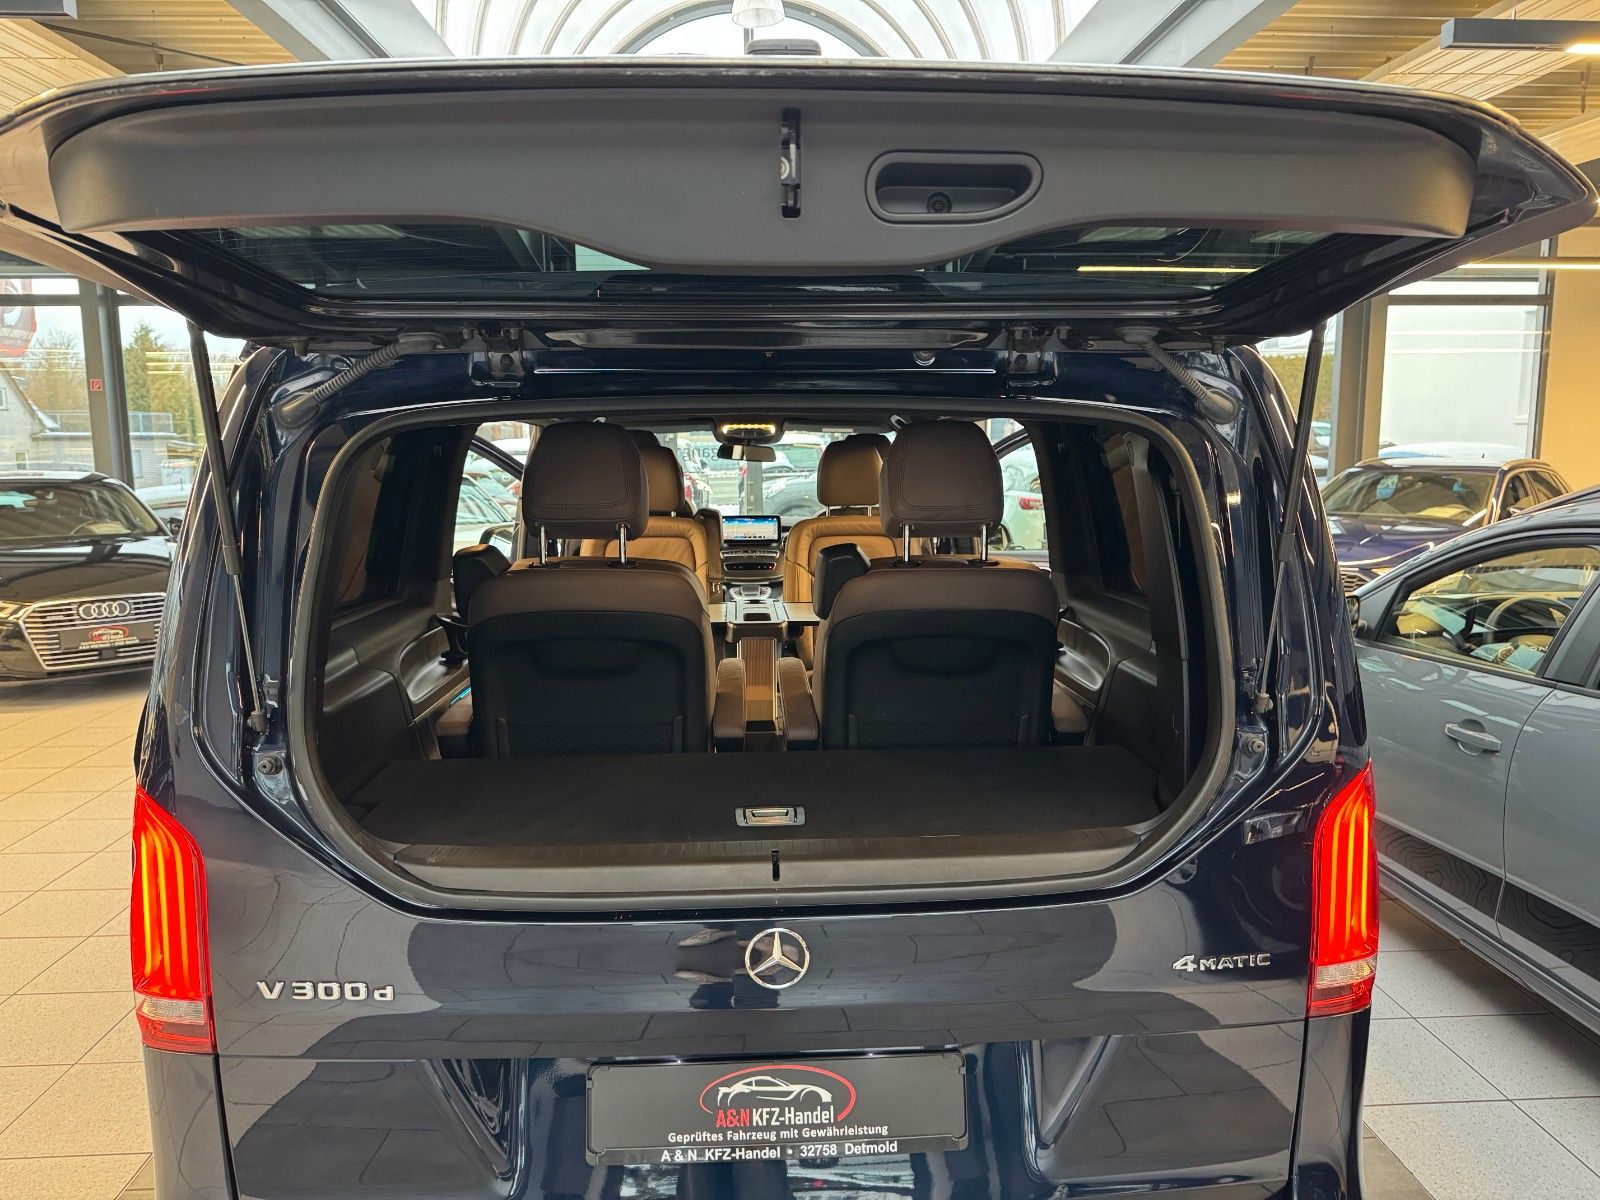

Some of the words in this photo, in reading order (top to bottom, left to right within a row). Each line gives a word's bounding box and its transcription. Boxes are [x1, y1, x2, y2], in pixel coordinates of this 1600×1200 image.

[1172, 953, 1271, 972] 4MATIC
[256, 981, 286, 1000] V
[292, 981, 395, 1001] 300d
[716, 1109, 749, 1128] A&N
[752, 1105, 834, 1127] KFZ-Handel
[668, 1130, 723, 1143] Geprüftes
[727, 1127, 777, 1141] Fahrzeug
[780, 1128, 799, 1139] mit
[802, 1125, 888, 1138] Gewährleistung
[660, 1151, 671, 1162] A
[687, 1150, 697, 1161] N
[705, 1147, 781, 1160] KFZ-Handel
[800, 1144, 837, 1157] 32758
[844, 1141, 898, 1155] Detmold
